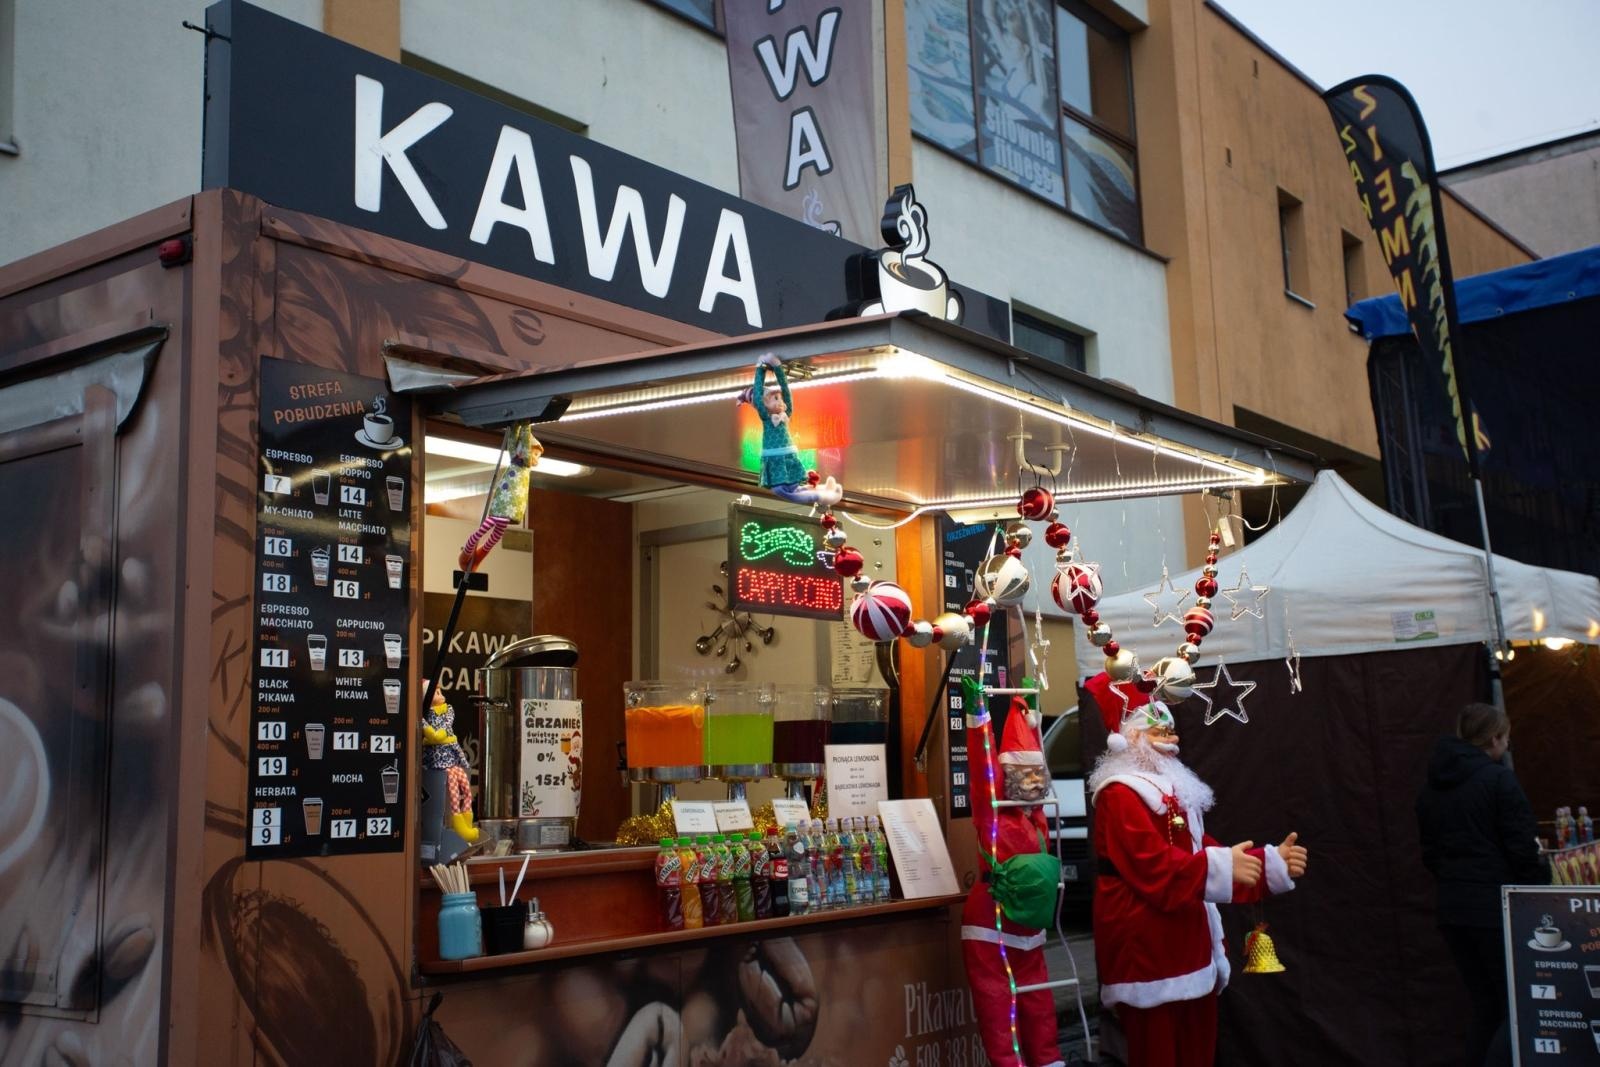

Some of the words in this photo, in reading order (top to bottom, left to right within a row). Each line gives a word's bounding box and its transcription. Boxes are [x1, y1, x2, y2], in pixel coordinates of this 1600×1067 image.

[355, 74, 763, 328] KAWA
[289, 381, 343, 400] STREFA
[274, 400, 365, 424] POBUDZENIA
[266, 448, 313, 464] ESPRESSO
[339, 454, 384, 469] ESPRESSO
[339, 467, 371, 480] DOPPIO
[272, 477, 283, 491] 7
[343, 487, 362, 504] 14
[263, 505, 314, 520] MY-CHIATO
[338, 509, 362, 520] LATTE
[338, 521, 387, 536] MACCHIATO
[268, 538, 288, 555] 16
[341, 546, 360, 562] 14
[266, 573, 287, 591] 18
[337, 582, 356, 597] 16
[261, 603, 310, 616] ESPRESSO
[260, 617, 314, 630] MACCHIATO
[336, 618, 385, 630] CAPPUCINO
[266, 651, 284, 666] 11
[342, 651, 360, 666] 13
[259, 679, 289, 689] BLACK
[335, 677, 362, 687] WHITE
[258, 693, 295, 703] PIKAWA
[335, 690, 369, 700] PIKAWA
[951, 698, 961, 709] 18
[525, 718, 581, 729] GRZANIEC
[952, 719, 961, 730] 20
[262, 724, 283, 739] 10
[338, 734, 355, 749] 11
[374, 737, 391, 752] 21
[537, 752, 556, 762] 0%
[262, 758, 283, 774] 19
[332, 774, 364, 783] MOCHA
[535, 772, 567, 786] 15zł
[955, 774, 965, 785] 11
[255, 787, 297, 796] HERBATA
[955, 796, 965, 808] 13
[262, 809, 272, 825] 8
[334, 821, 353, 836] 17
[370, 819, 389, 834] 32
[262, 828, 271, 844] 9
[1535, 961, 1579, 970] ESPRESSO
[1539, 986, 1548, 998] 7
[904, 982, 966, 1038] Pikawa
[1538, 1009, 1583, 1019] ESPRESSO
[1538, 1020, 1588, 1030] MACCHIATO
[1540, 1040, 1556, 1053] 11
